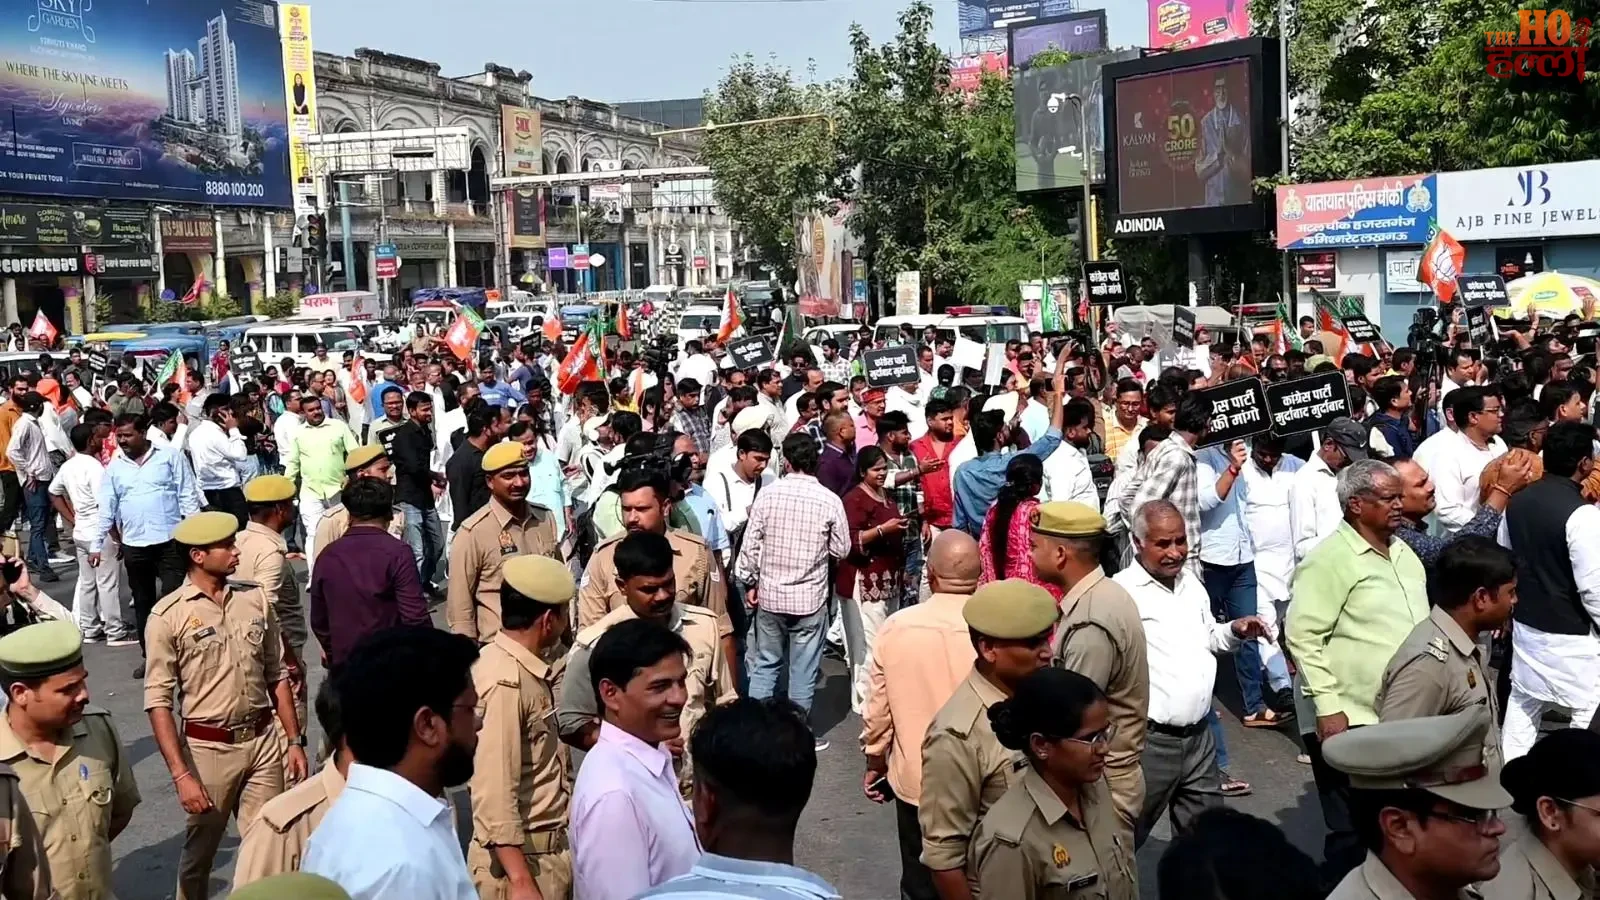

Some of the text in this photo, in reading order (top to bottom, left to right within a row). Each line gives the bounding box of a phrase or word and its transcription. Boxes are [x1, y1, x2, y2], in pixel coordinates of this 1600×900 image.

[42, 12, 80, 30] GARDEN
[6, 60, 129, 90] WHERE THE SKYLINE MEETS
[1167, 113, 1196, 139] 50
[1123, 131, 1156, 147] KALYAN
[1164, 138, 1198, 152] CRORE
[8, 171, 24, 179] YOUR
[25, 173, 48, 181] PRIVATE
[48, 174, 63, 182] TOUR
[205, 180, 264, 197] 8880 100 200
[1304, 193, 1346, 212] यातायात
[1346, 183, 1377, 219] पुलिस
[1114, 216, 1166, 234] ADINDIA
[1456, 207, 1600, 231] AJB FINE JEWEL
[1230, 388, 1256, 408] पार्टी
[1281, 383, 1332, 407] कांग्रेस पार्टी
[1229, 406, 1261, 426] मांगो
[1274, 399, 1345, 427] मुर्दाबाद मुर्दाबाद
